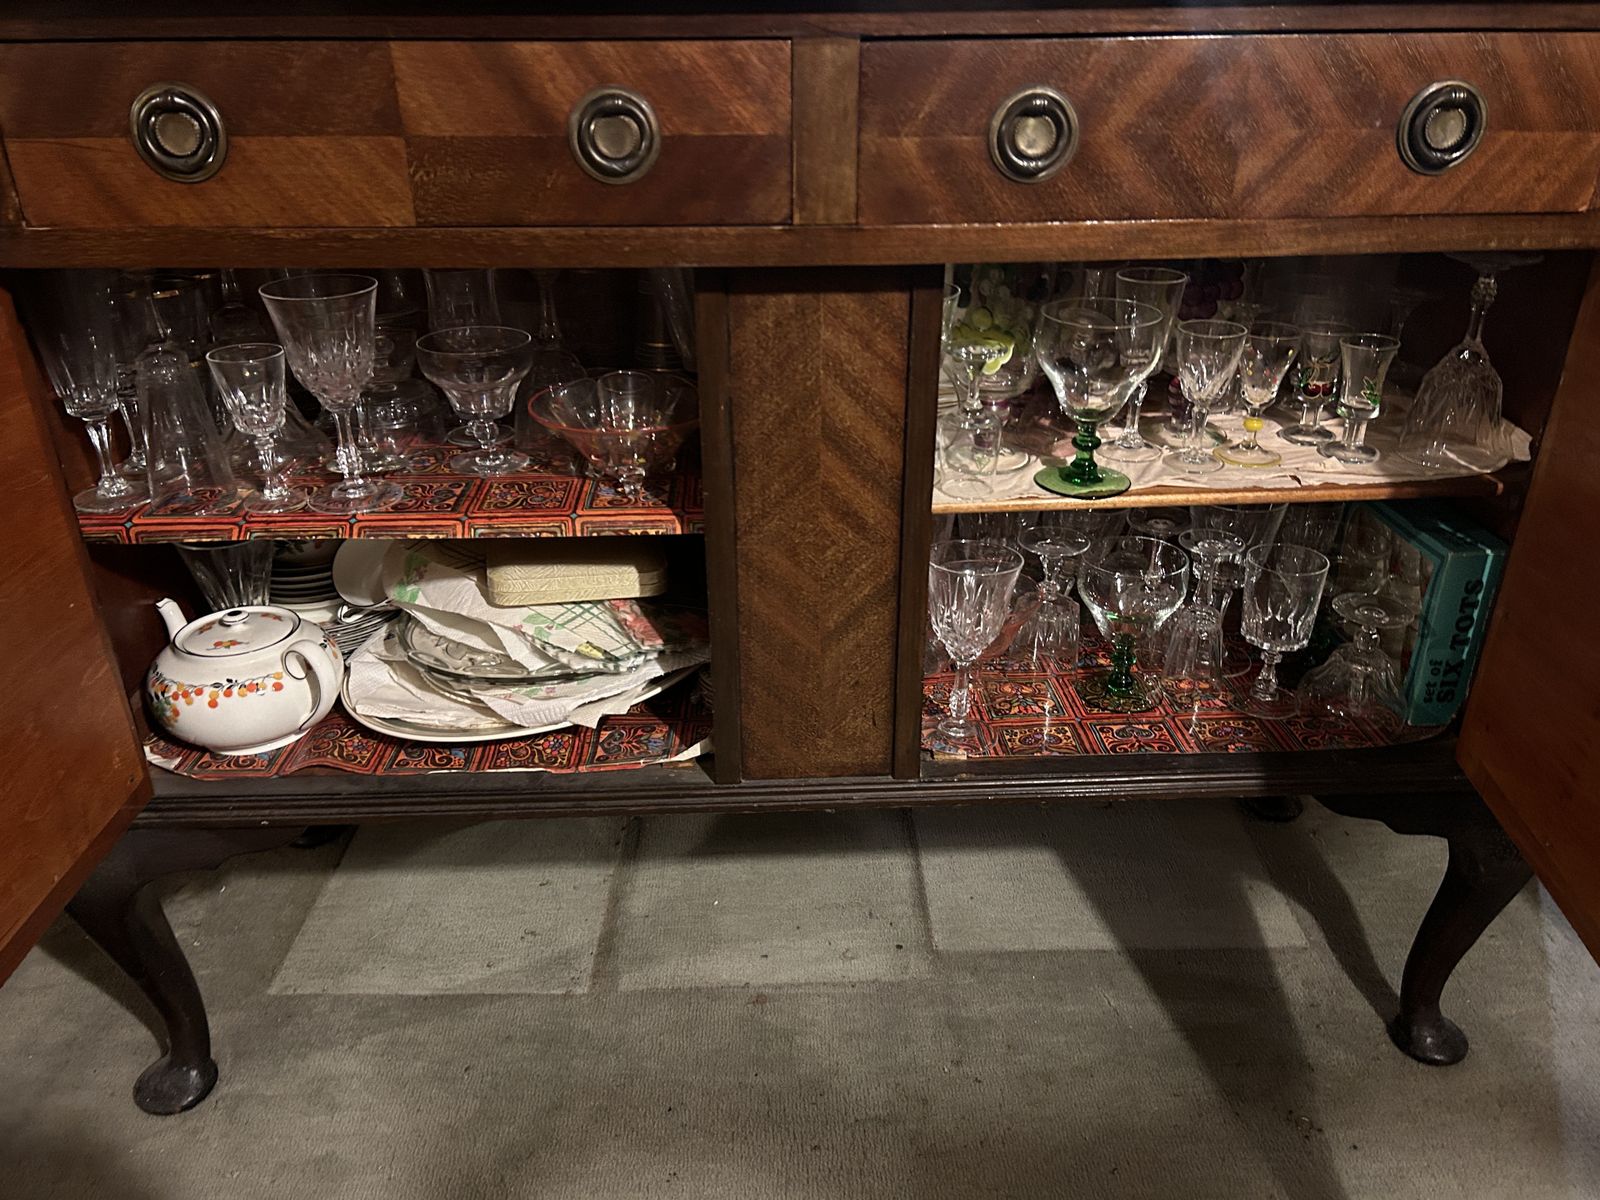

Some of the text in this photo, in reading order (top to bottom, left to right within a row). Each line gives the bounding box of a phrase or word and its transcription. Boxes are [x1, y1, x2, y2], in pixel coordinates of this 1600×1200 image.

[1429, 659, 1443, 676] of
[1436, 579, 1484, 704] SIX TOTS
